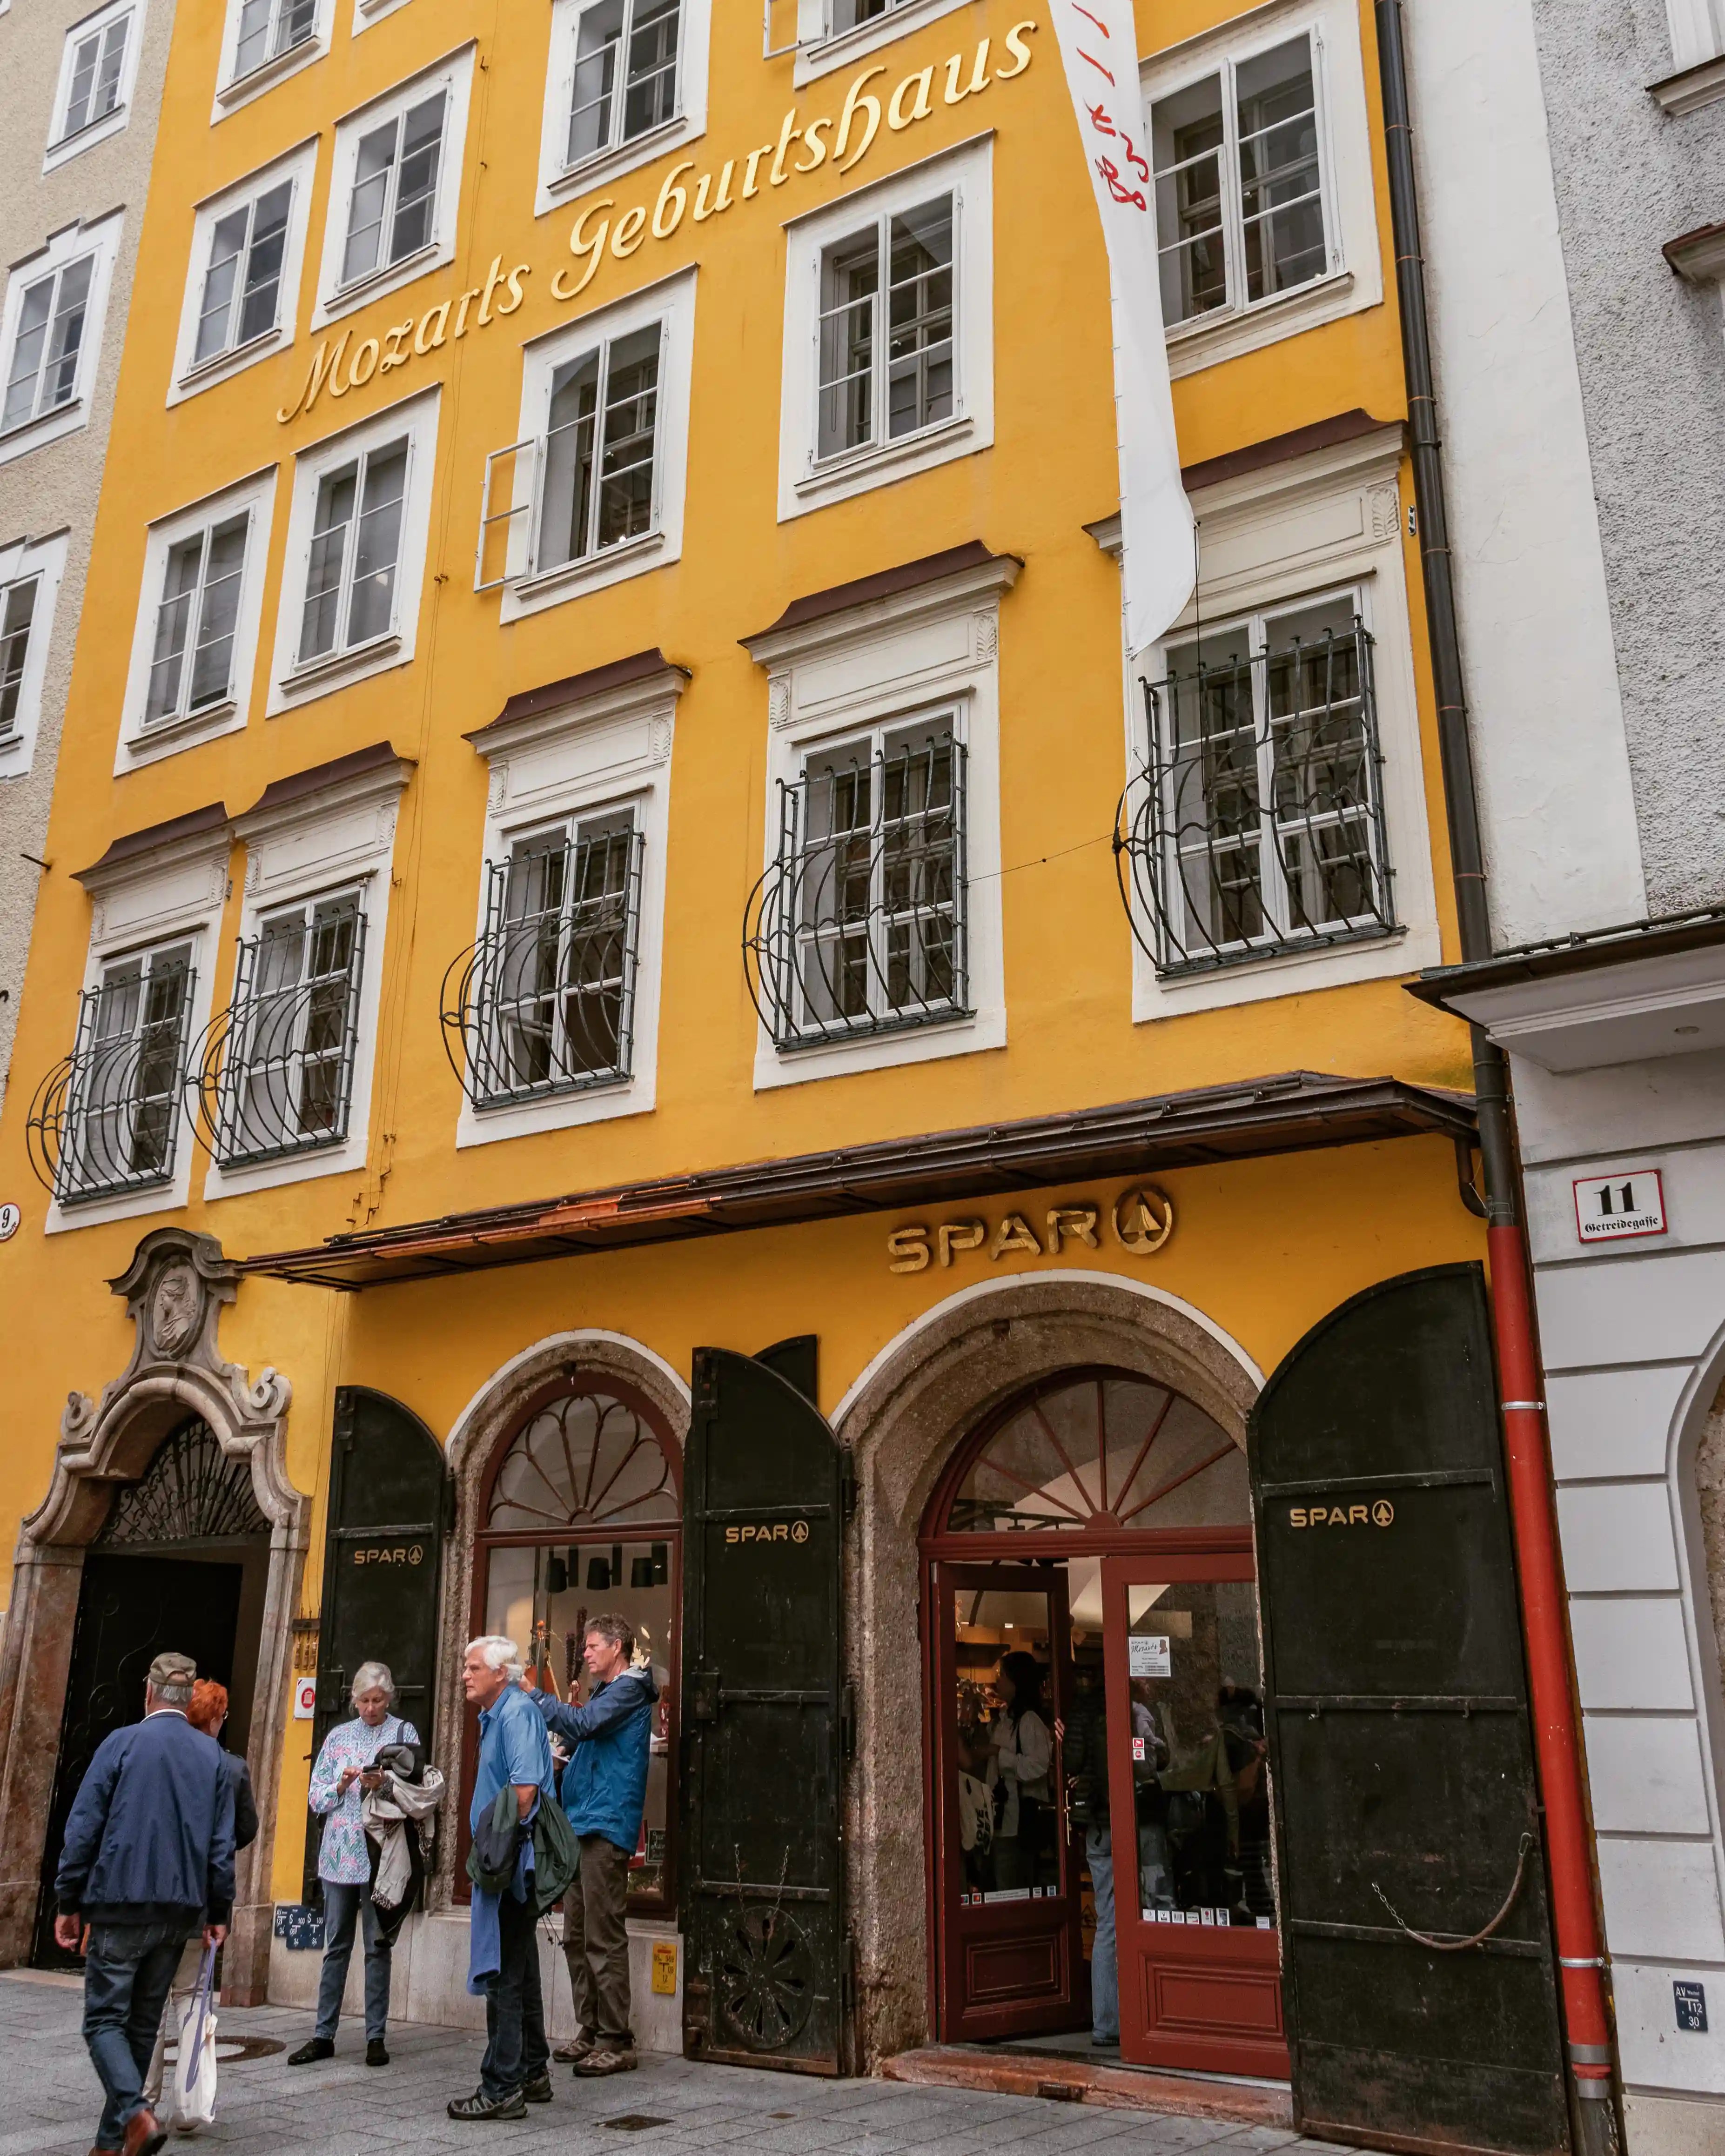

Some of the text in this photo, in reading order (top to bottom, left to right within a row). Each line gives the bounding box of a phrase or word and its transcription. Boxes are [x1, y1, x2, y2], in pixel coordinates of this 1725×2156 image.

[276, 254, 531, 423] Mozarts
[550, 20, 1038, 300] Geburtshaus
[1594, 1182, 1641, 1216] 11
[2, 1208, 10, 1228] 9
[1584, 1216, 1658, 1232] Getreidegasse
[887, 1206, 1098, 1273] SPAR
[1290, 1505, 1369, 1527] SPAR
[726, 1524, 788, 1543] SPAR
[354, 1549, 406, 1565] SPAR
[1676, 1986, 1685, 1997] AV
